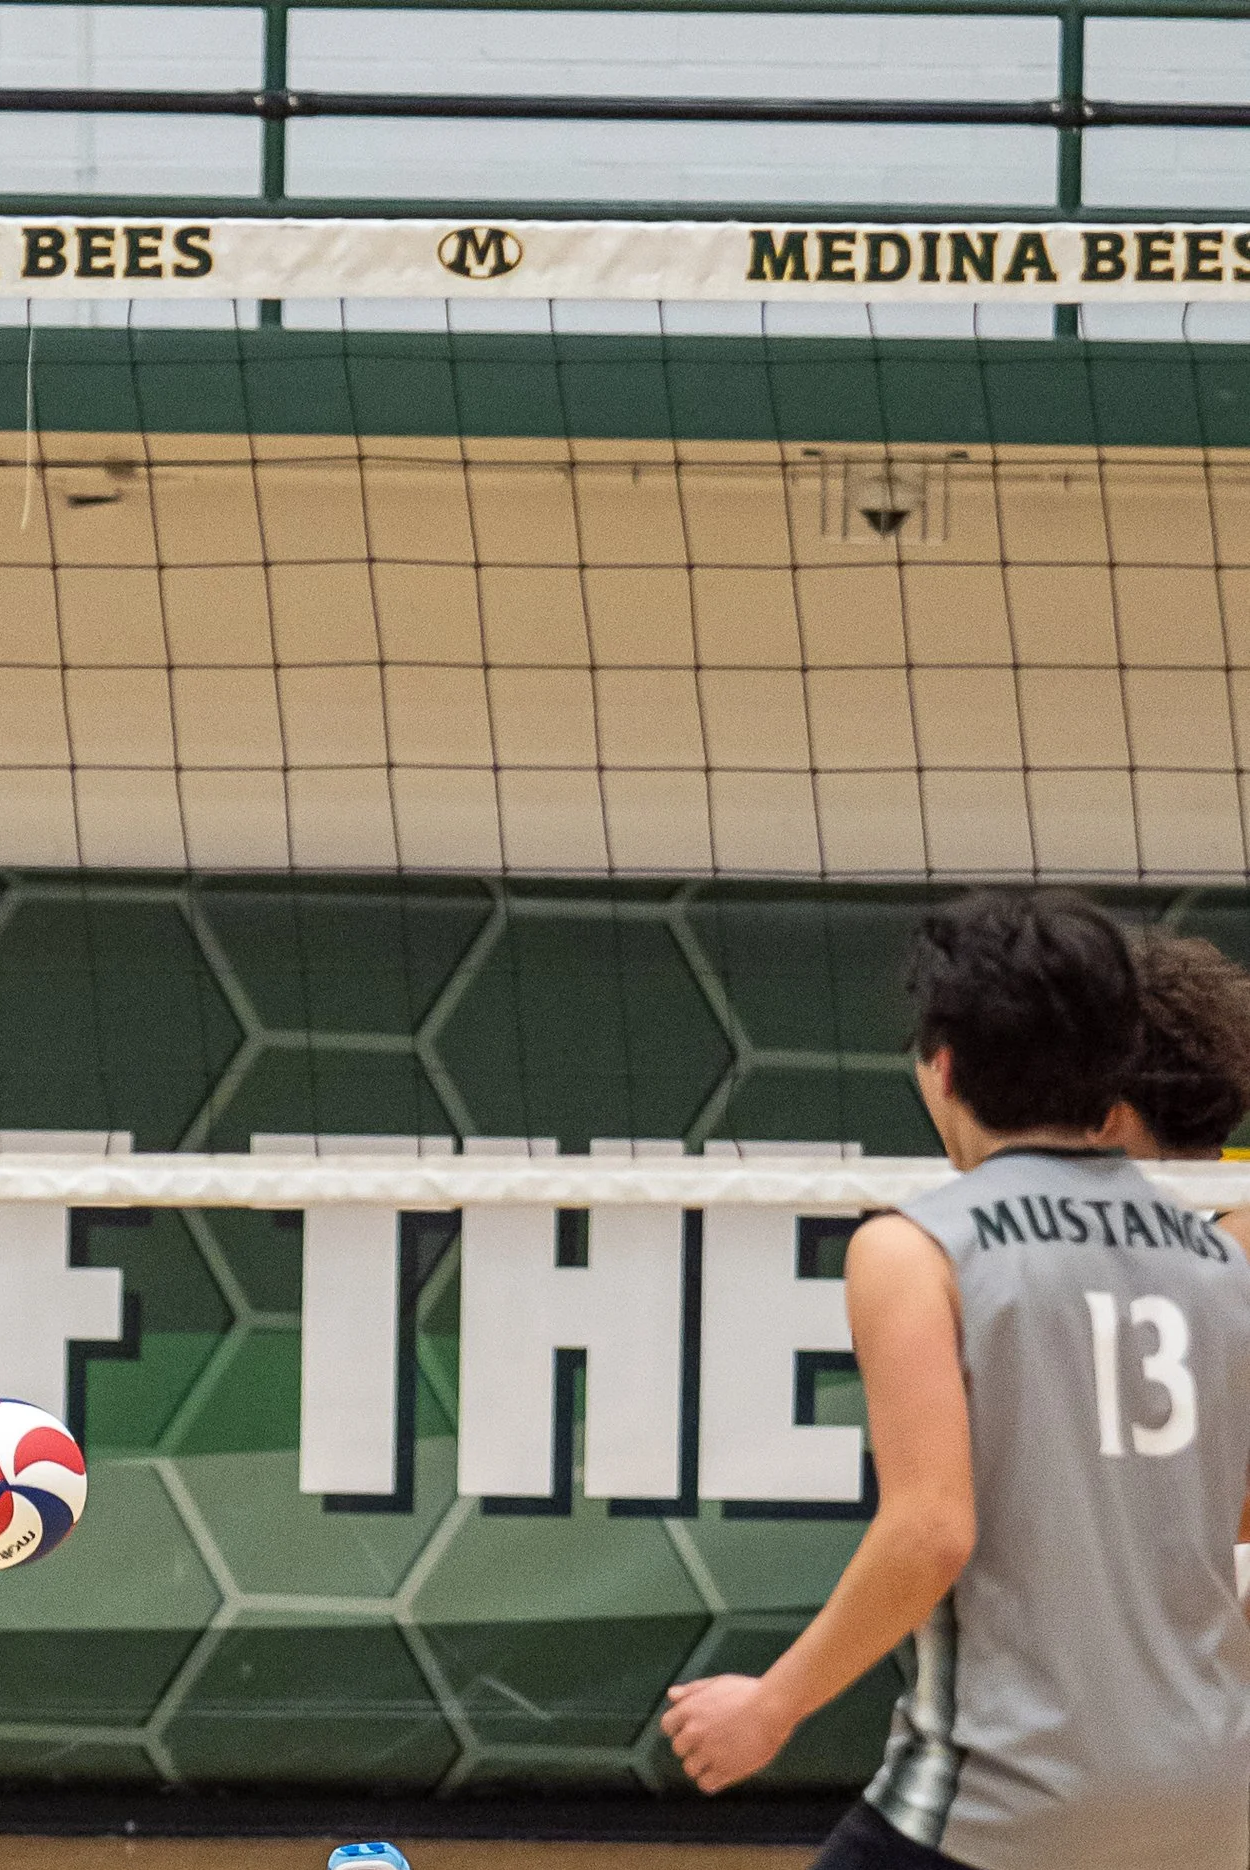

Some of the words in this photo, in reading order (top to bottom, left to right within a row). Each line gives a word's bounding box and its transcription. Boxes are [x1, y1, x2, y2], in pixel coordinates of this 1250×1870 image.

[21, 225, 214, 279] BEES
[447, 227, 513, 276] M
[748, 229, 1058, 284] MEDINA
[969, 1194, 1230, 1263] MUSTANGS
[250, 1131, 864, 1502] THE
[1084, 1290, 1198, 1457] 13
